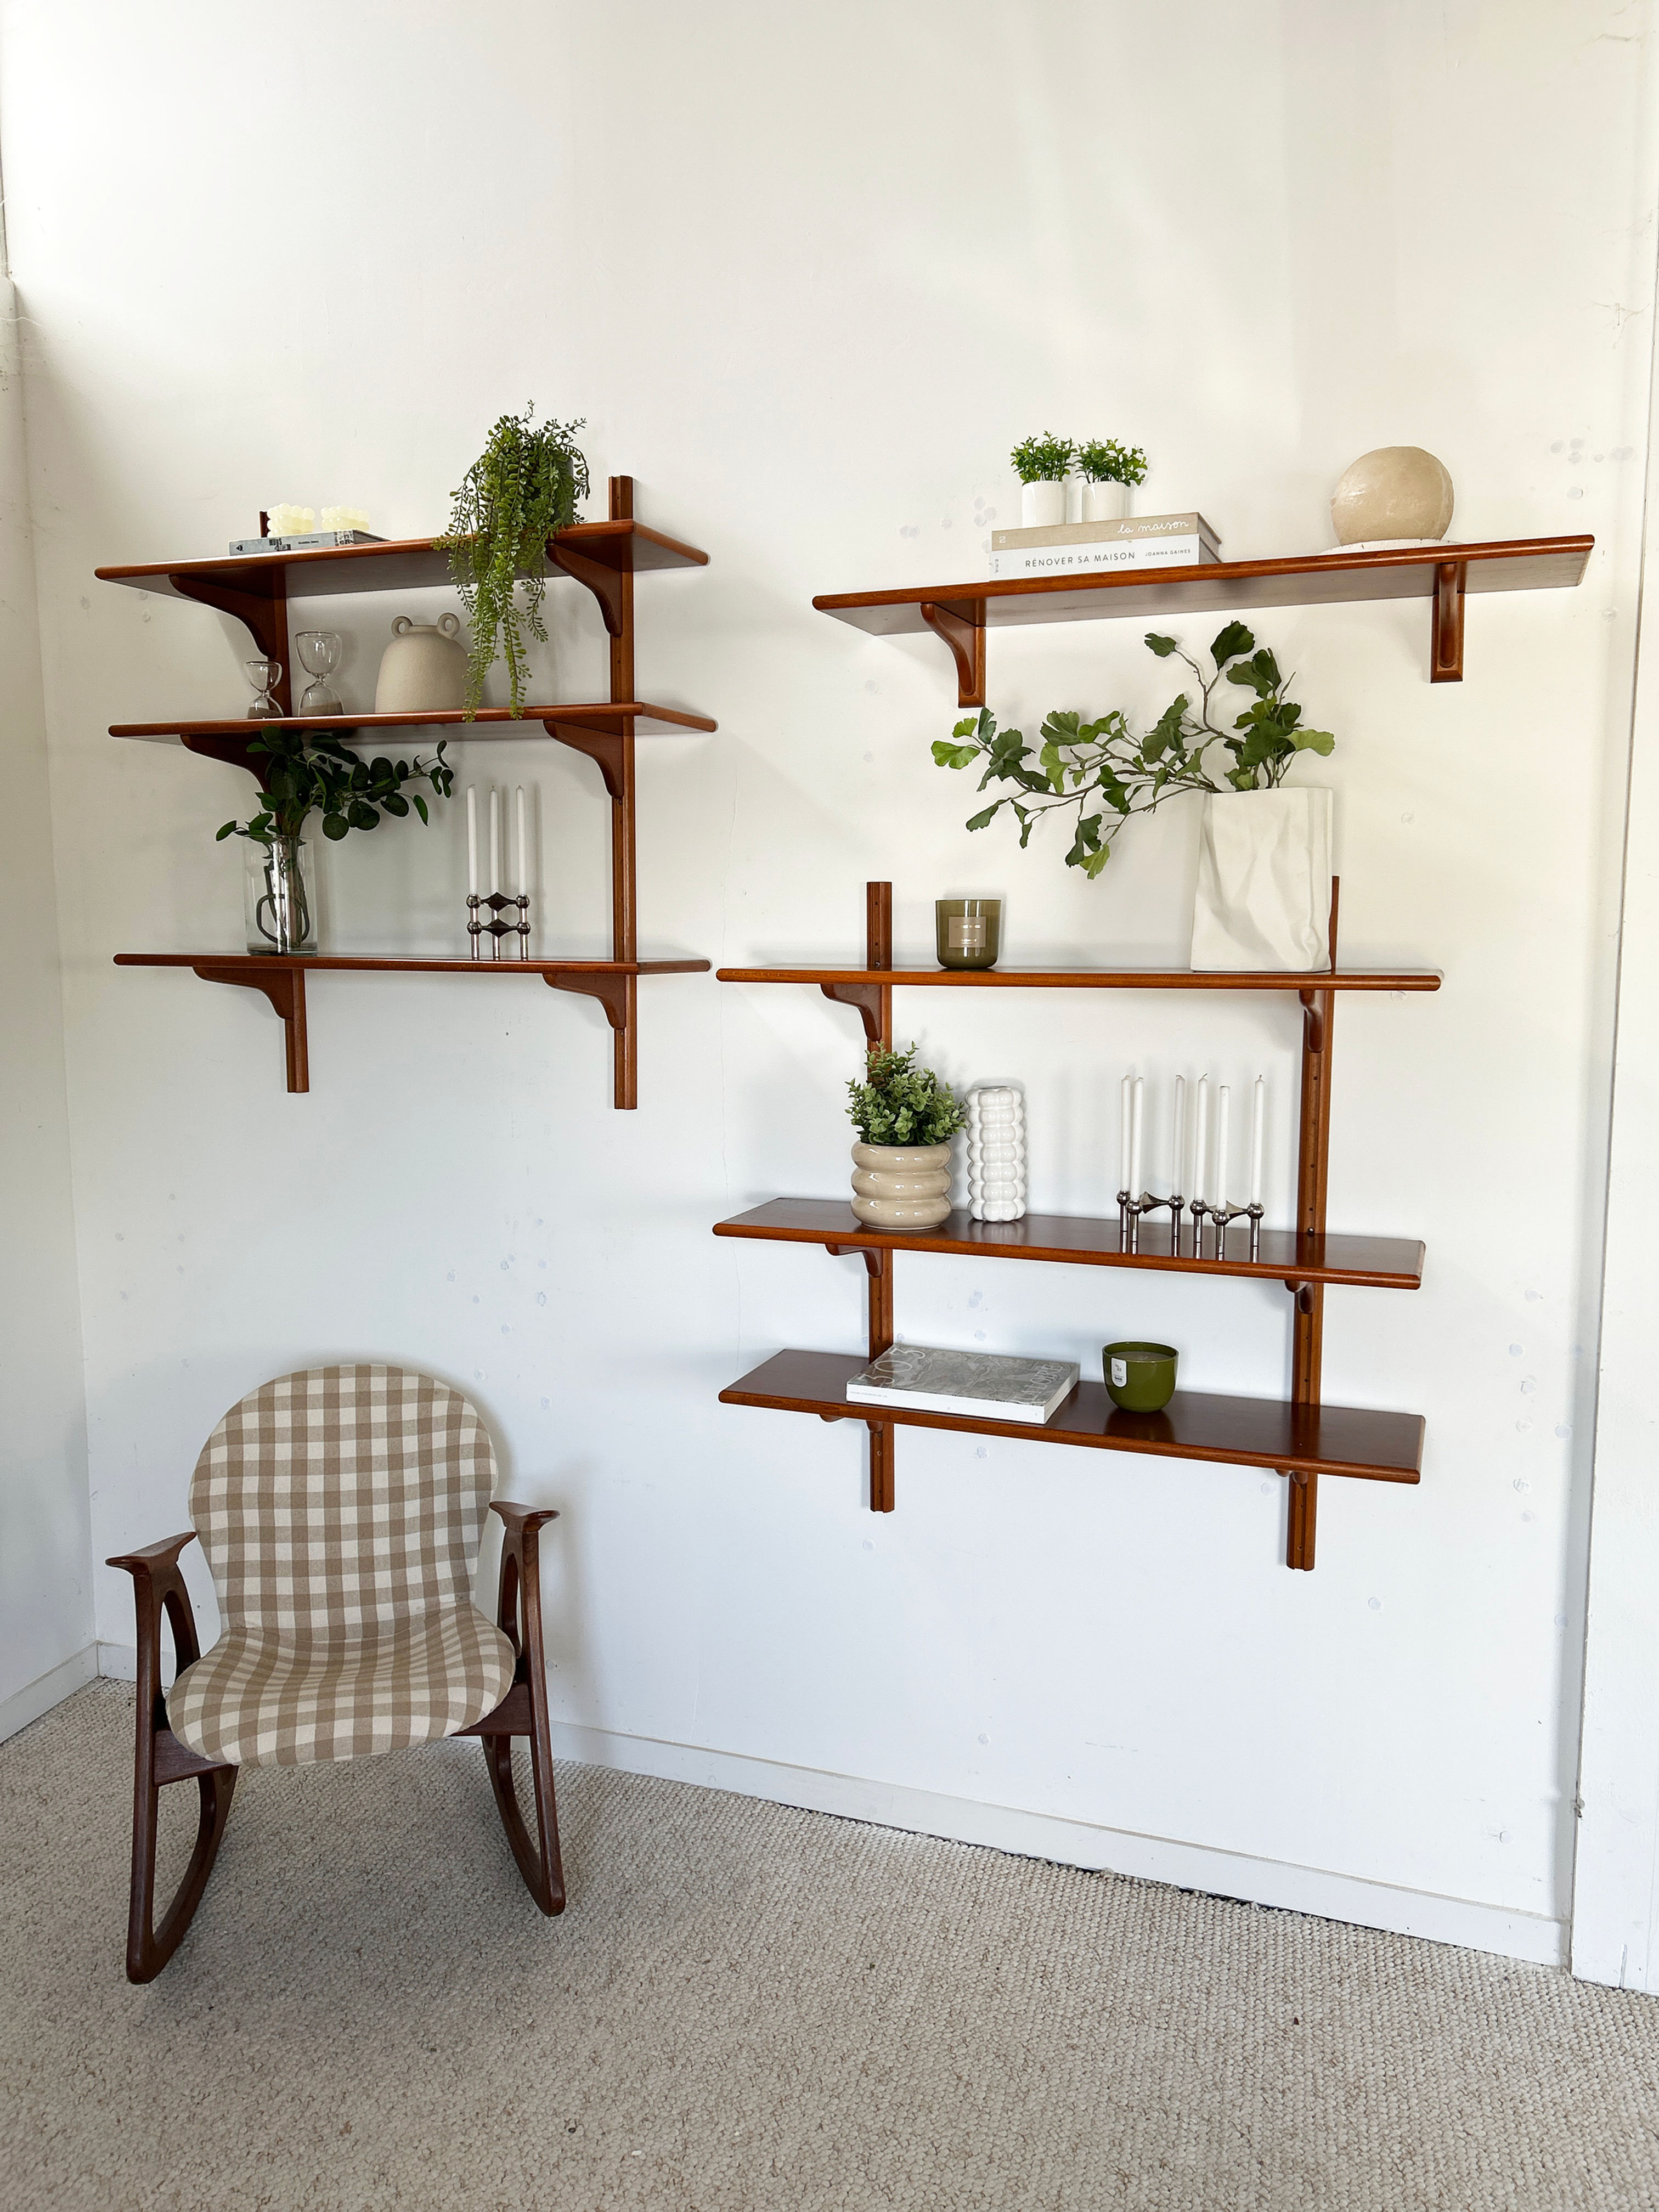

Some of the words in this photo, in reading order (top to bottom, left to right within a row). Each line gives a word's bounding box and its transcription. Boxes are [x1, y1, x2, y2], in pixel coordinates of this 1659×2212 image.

[1118, 524, 1134, 534] la
[1138, 521, 1189, 531] maison
[1025, 556, 1074, 568] RÉNOVER
[1077, 555, 1090, 563] SA
[1093, 552, 1135, 562] MAISON
[857, 1347, 926, 1384] 303
[1024, 1364, 1064, 1389] LOIRE
